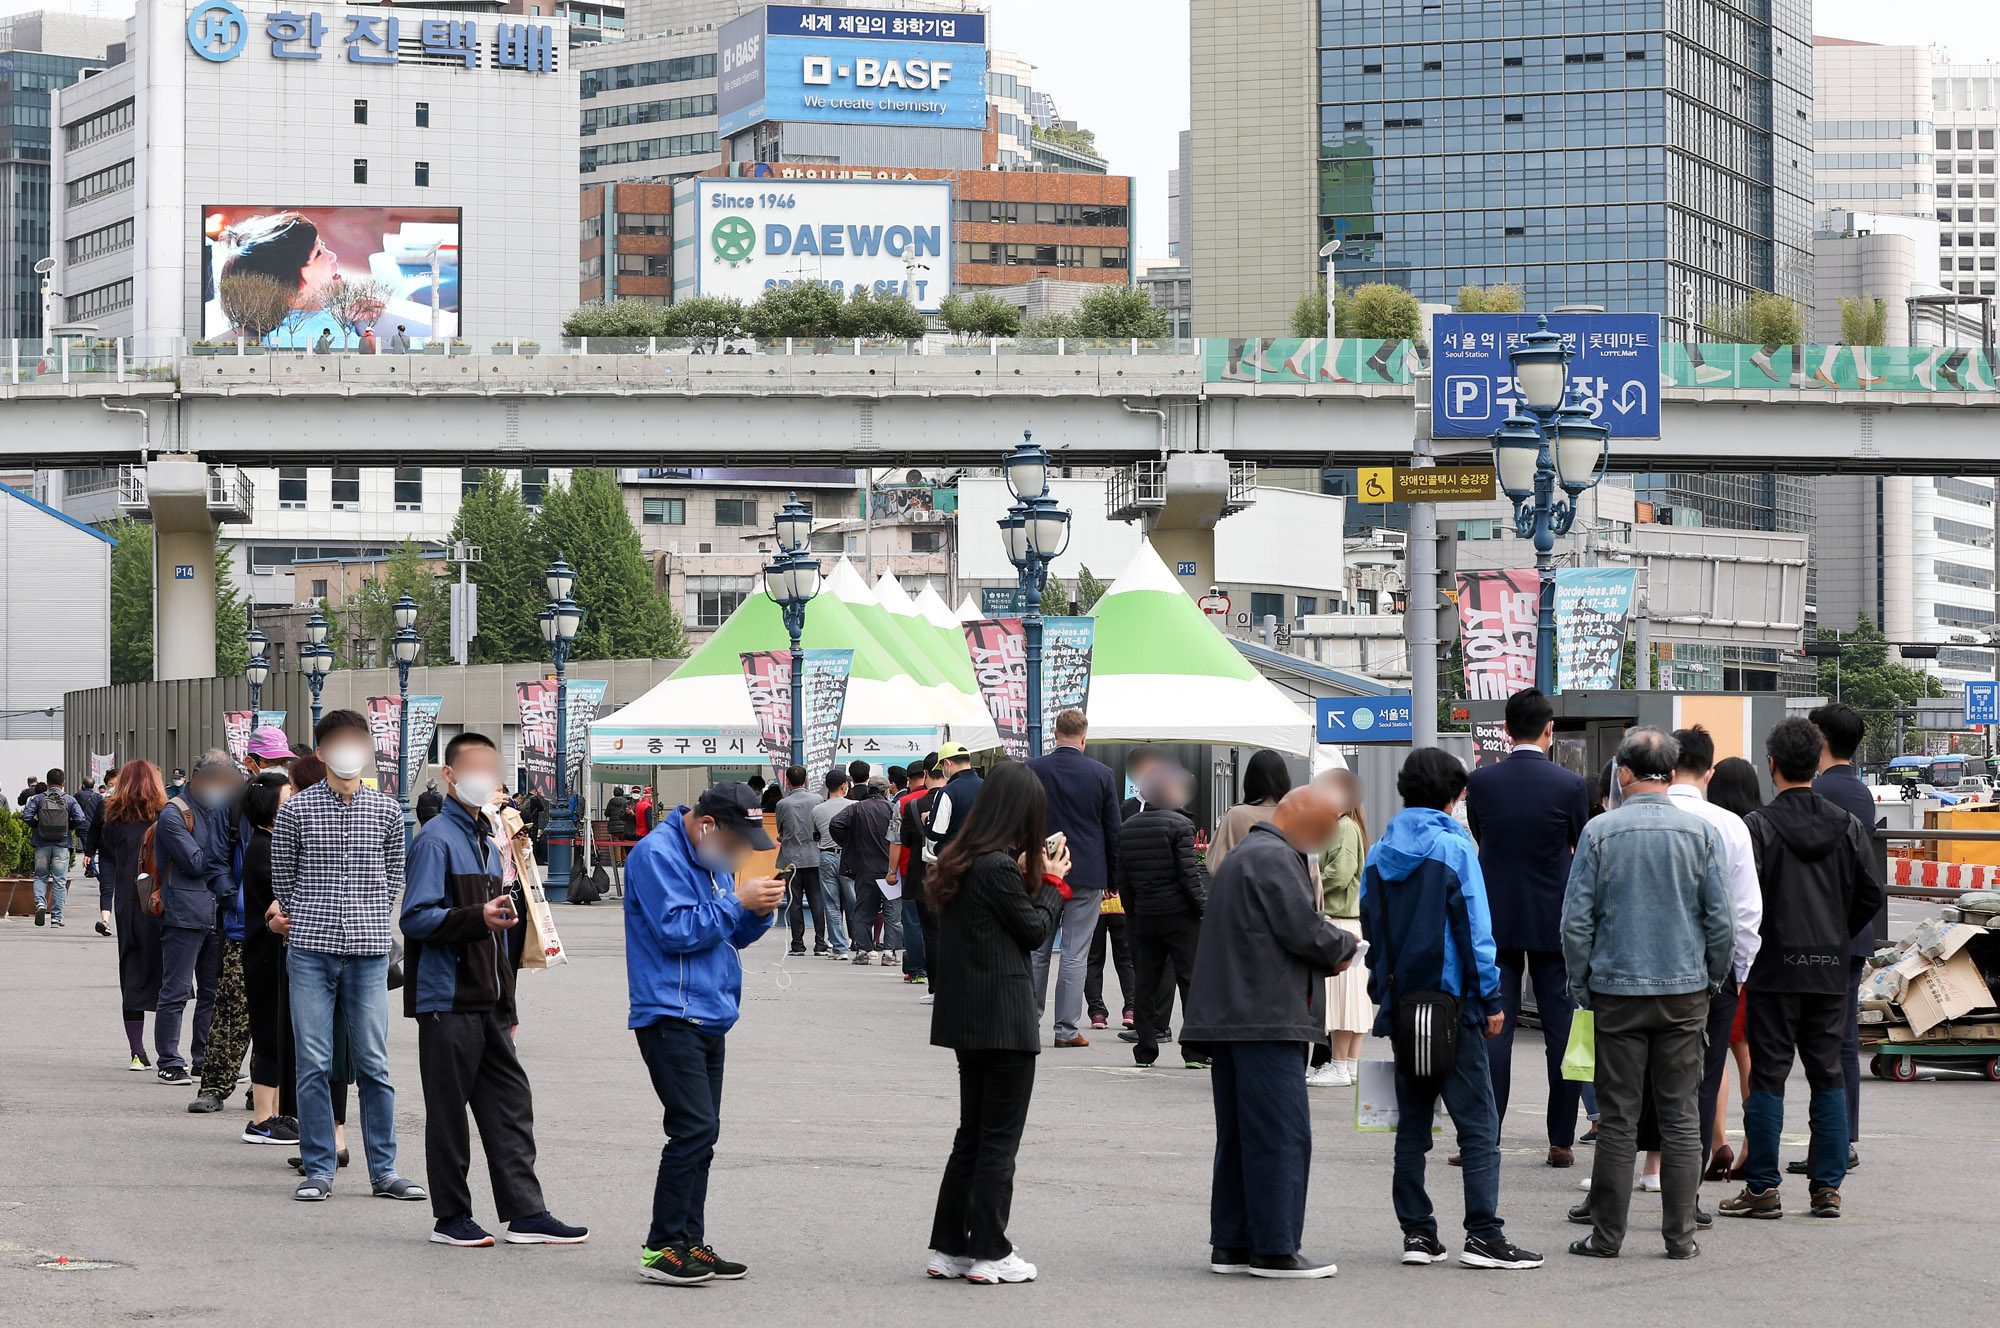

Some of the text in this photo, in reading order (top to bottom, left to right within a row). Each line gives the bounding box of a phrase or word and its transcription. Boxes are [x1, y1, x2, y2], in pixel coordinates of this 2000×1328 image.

[800, 14, 956, 37] 세계 제일의 화학기업
[266, 11, 553, 72] 한진택배
[736, 34, 760, 68] BASF
[856, 56, 953, 90] BASF
[804, 94, 947, 116] We create chemistry
[712, 193, 796, 208] Since 1946
[765, 224, 941, 257] DAEWON
[1443, 332, 1495, 350] 서울역
[1589, 332, 1649, 349] 롯데마트
[1466, 350, 1489, 358] Station
[1456, 382, 1479, 414] P
[1496, 376, 1609, 420] 주장
[1400, 474, 1489, 486] 장애인콜택시 승강장
[176, 567, 193, 577] P14
[1178, 564, 1195, 573] P13
[1557, 584, 1627, 597] Border-less.site
[1379, 708, 1409, 720] 서울역
[1783, 954, 1841, 967] KAPPA
